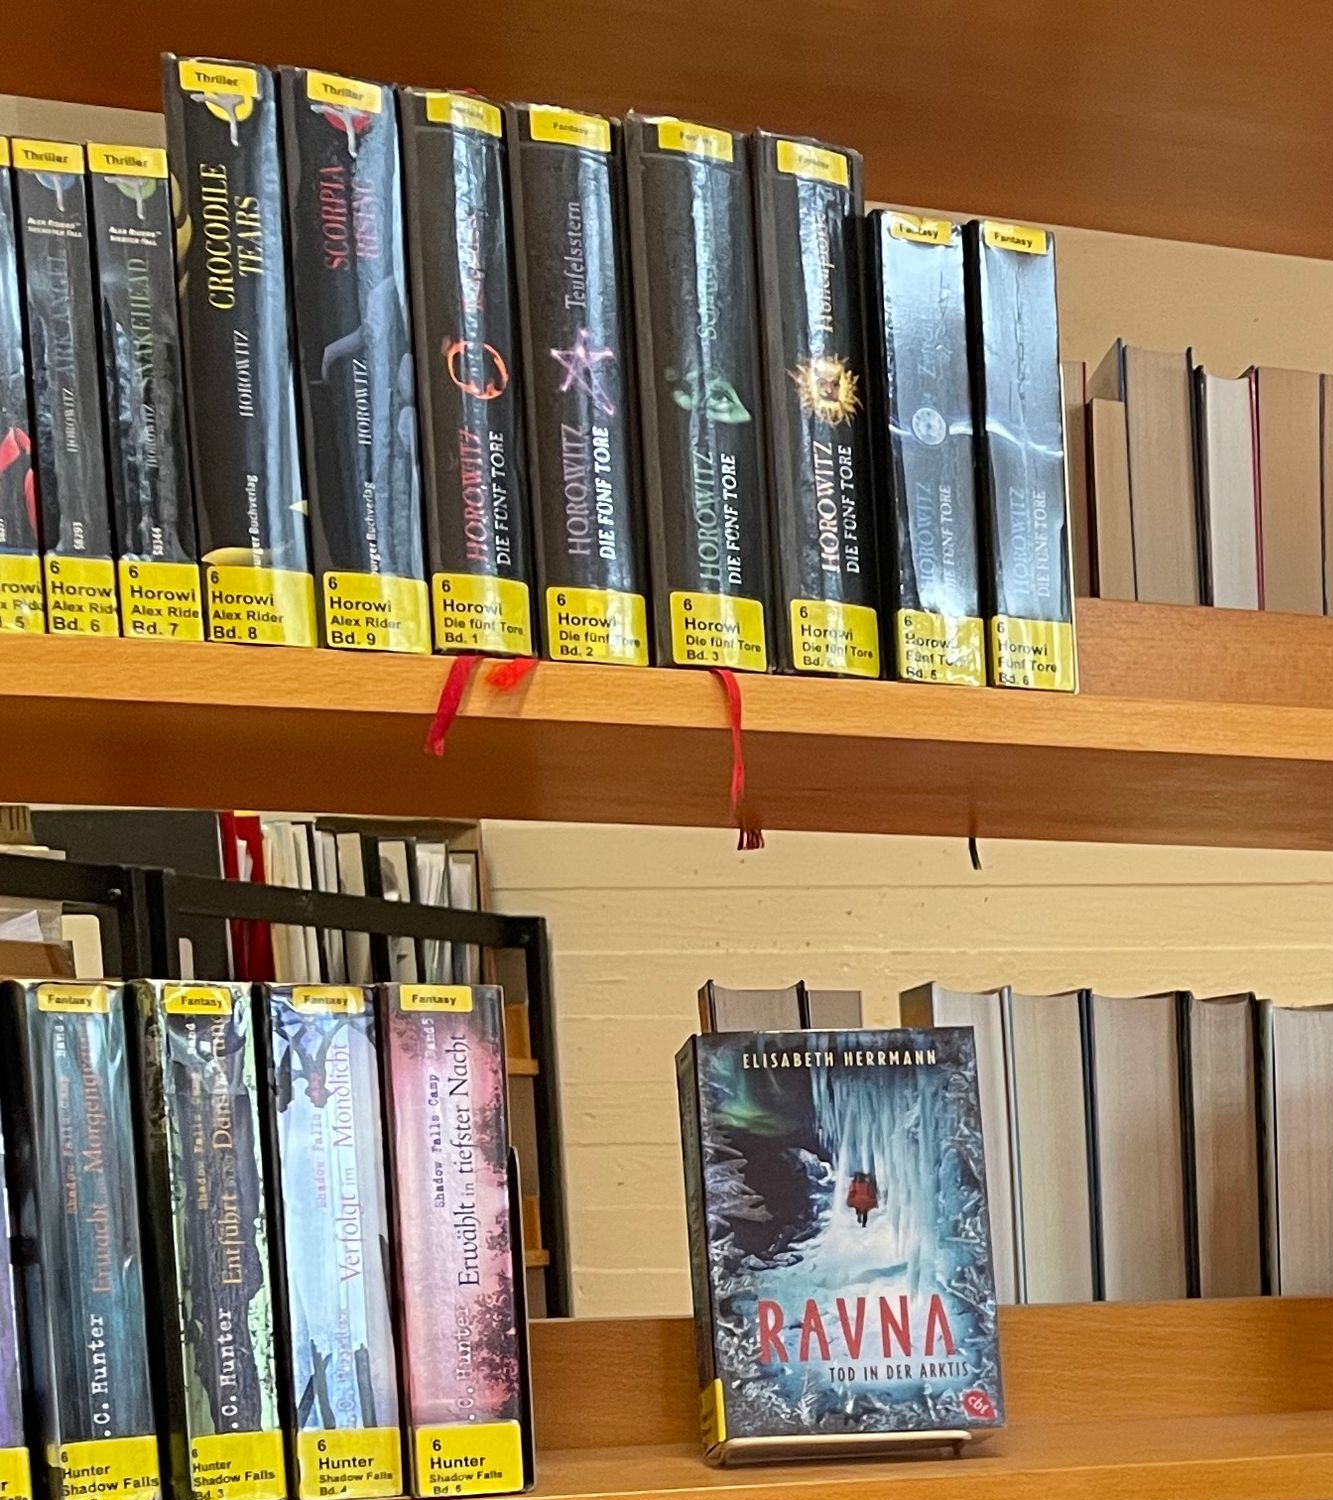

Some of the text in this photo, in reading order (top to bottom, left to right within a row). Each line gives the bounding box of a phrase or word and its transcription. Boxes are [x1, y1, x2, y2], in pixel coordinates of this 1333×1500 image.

[208, 162, 236, 310] CROCODILE
[237, 194, 262, 277] TEARS
[323, 164, 351, 272] SCORPIA
[565, 200, 582, 311] Teufelsstern
[236, 328, 255, 418] HOROWITZ
[593, 426, 611, 470] TORE
[561, 423, 590, 556] HOROWITZ
[598, 523, 616, 561] DIE
[212, 591, 274, 606] Horowi
[213, 611, 284, 623] Alex Rider
[214, 626, 257, 639] Bd. 8
[742, 1049, 937, 1069] ELISABETH HERRMANN
[446, 1032, 480, 1287] Erwählt in tiefster Nacht
[757, 1294, 957, 1363] RAVNA
[829, 1361, 969, 1383] TOD IN DER ARKTIS
[966, 1393, 991, 1415] cbl
[430, 1455, 486, 1469] Hunter
